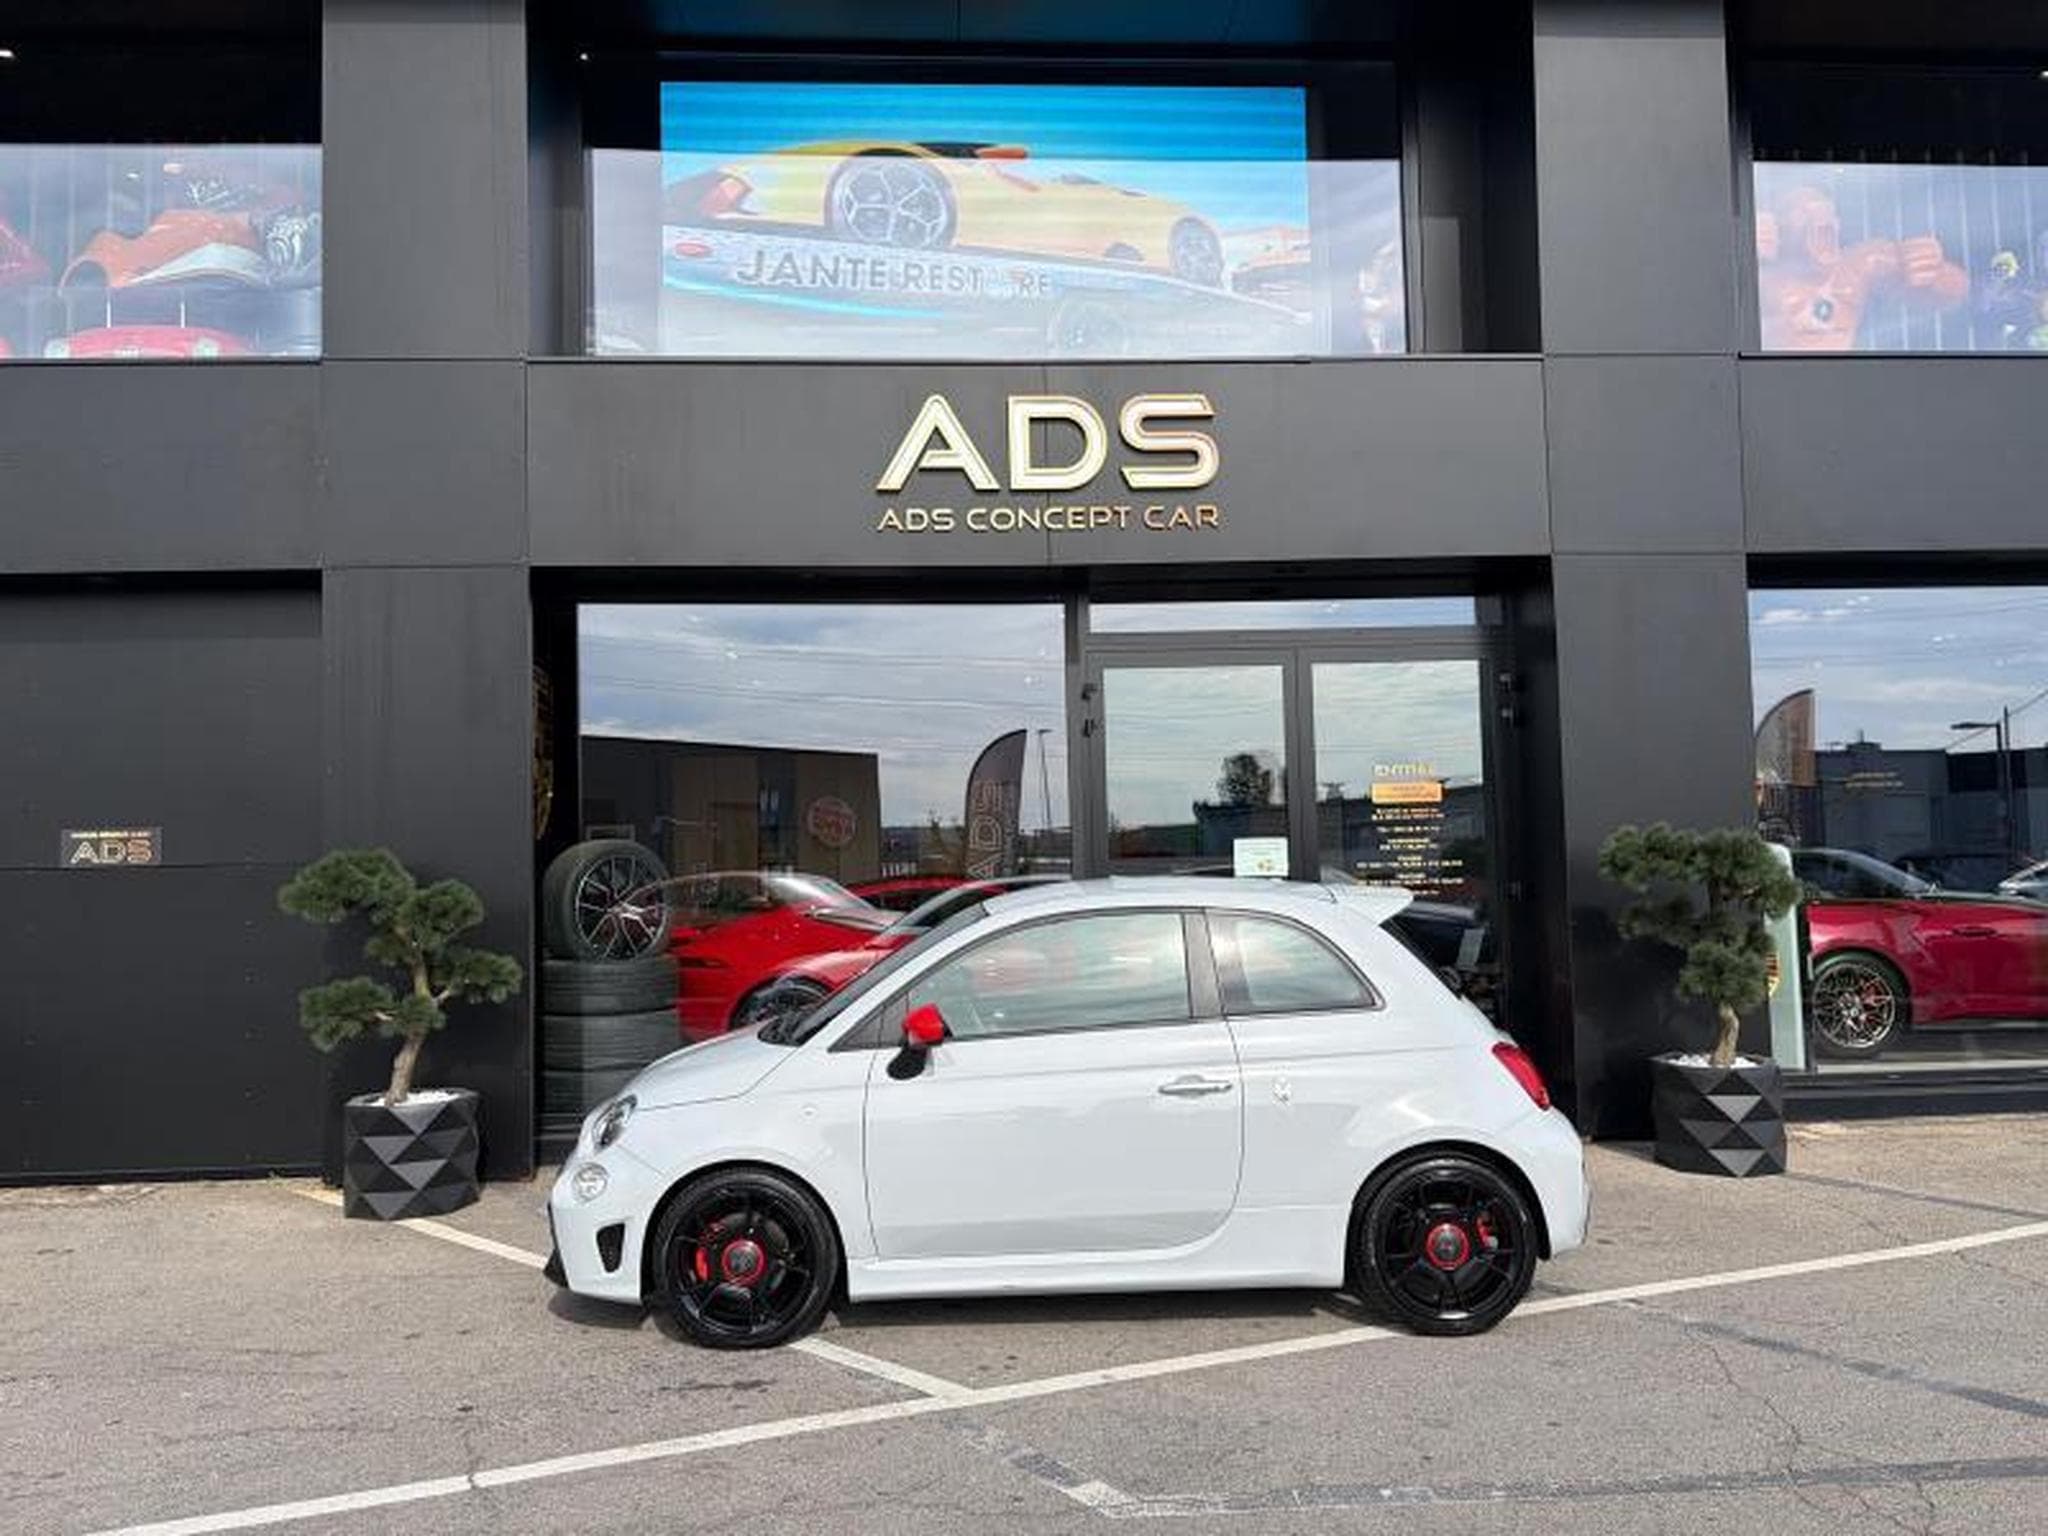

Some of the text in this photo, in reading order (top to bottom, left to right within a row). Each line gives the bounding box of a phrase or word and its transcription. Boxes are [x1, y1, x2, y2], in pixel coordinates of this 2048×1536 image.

[736, 250, 1050, 294] JANTE RESTRE
[875, 393, 1220, 491] ADS
[877, 504, 1220, 532] ADS CONCEPT CAR
[70, 840, 152, 864] ADS
